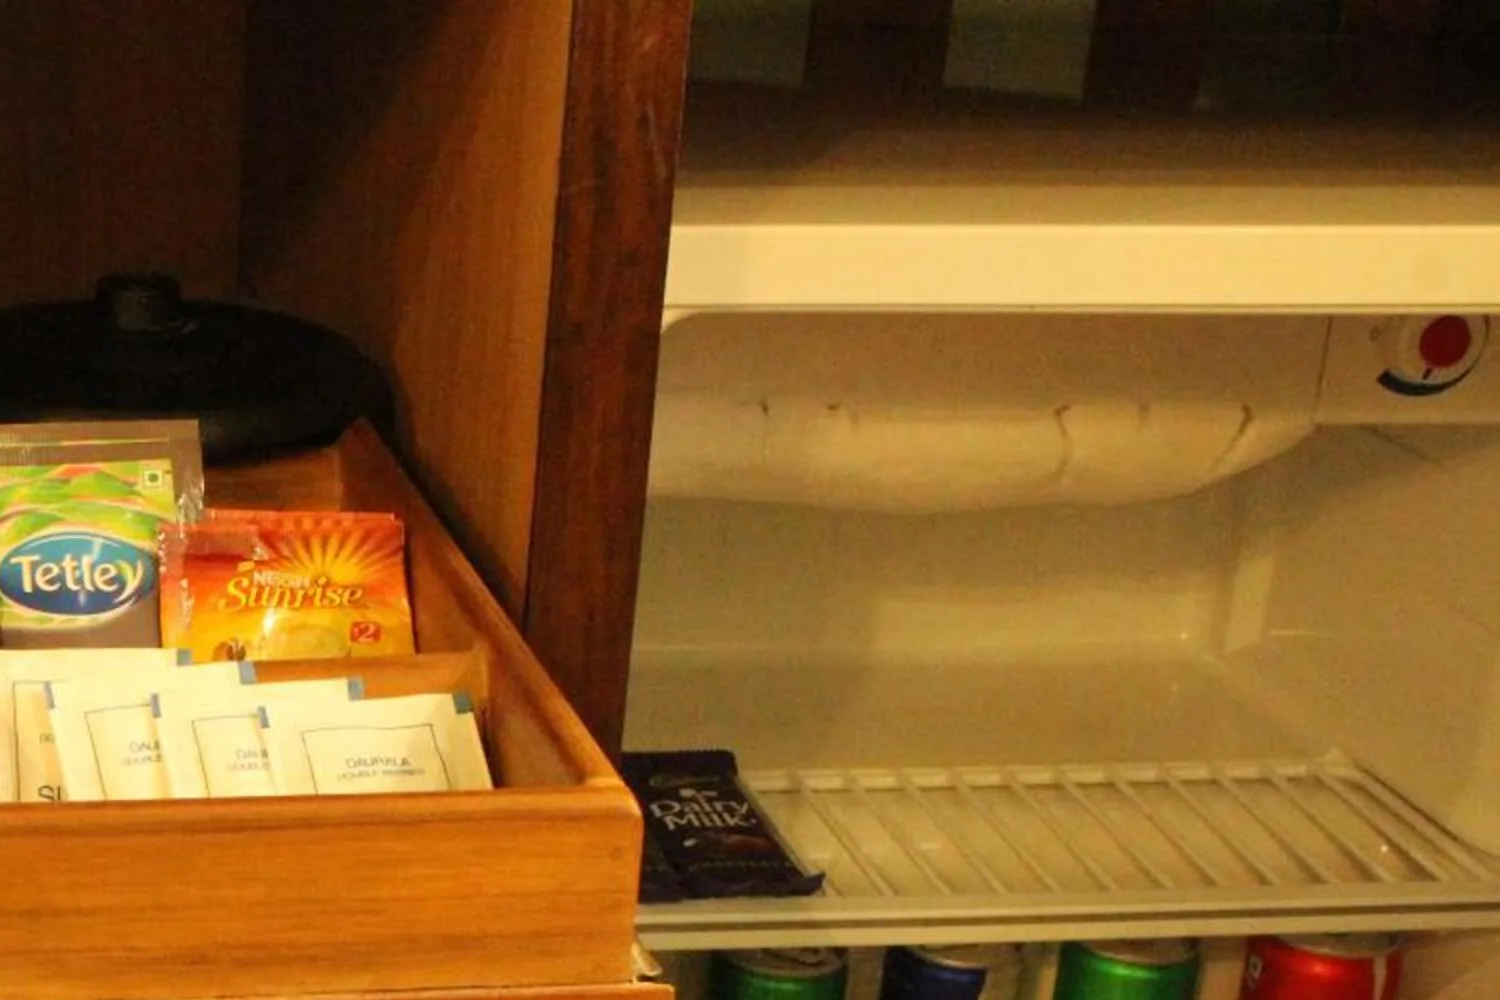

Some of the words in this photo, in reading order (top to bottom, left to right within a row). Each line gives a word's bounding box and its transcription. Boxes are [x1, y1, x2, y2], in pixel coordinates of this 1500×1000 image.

[9, 553, 143, 604] Tetley
[217, 576, 363, 612] Sunrise
[649, 794, 749, 819] Dairy
[662, 812, 752, 832] Milk
